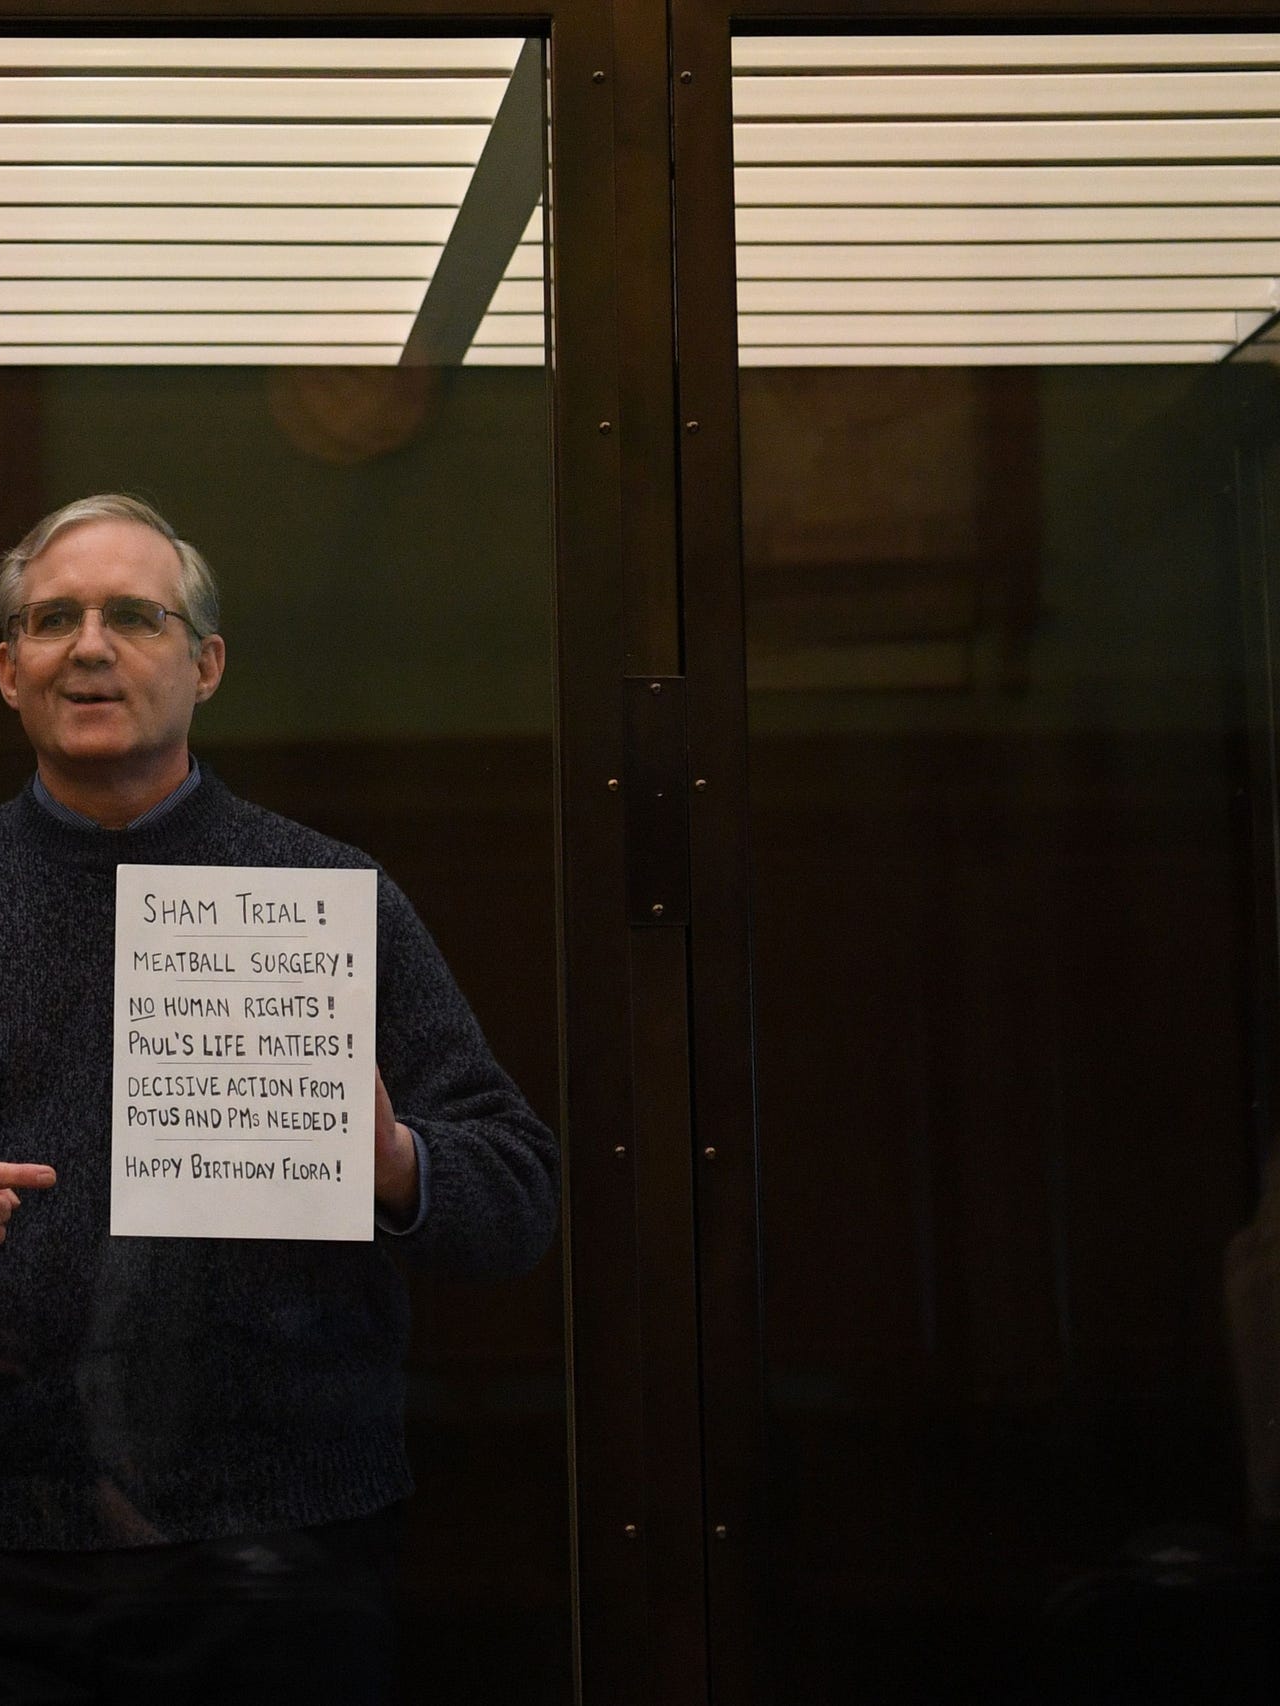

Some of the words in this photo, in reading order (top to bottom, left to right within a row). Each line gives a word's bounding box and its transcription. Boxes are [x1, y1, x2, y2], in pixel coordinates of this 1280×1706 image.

[144, 893, 217, 925] SHAM
[236, 892, 327, 925] TRIAL!
[133, 951, 235, 972] MEATBALL
[251, 952, 354, 977] SURGERY!
[130, 997, 155, 1014] NO
[165, 997, 230, 1017] HUMAN
[245, 996, 335, 1019] RIGHTS!
[129, 1030, 193, 1055] PAUL'S
[203, 1034, 245, 1056] LIFE
[259, 1034, 353, 1058] MATTERS!
[128, 1076, 220, 1098] DECISIVE
[227, 1077, 293, 1098] ACTION
[300, 1077, 345, 1100] FROM
[128, 1106, 179, 1127] POTUS
[185, 1108, 221, 1128] AND
[268, 1112, 348, 1133] NEEDED!
[125, 1156, 182, 1179] HAPPY
[191, 1154, 275, 1179] BIRTHDAY
[283, 1157, 342, 1182] FLORA!
